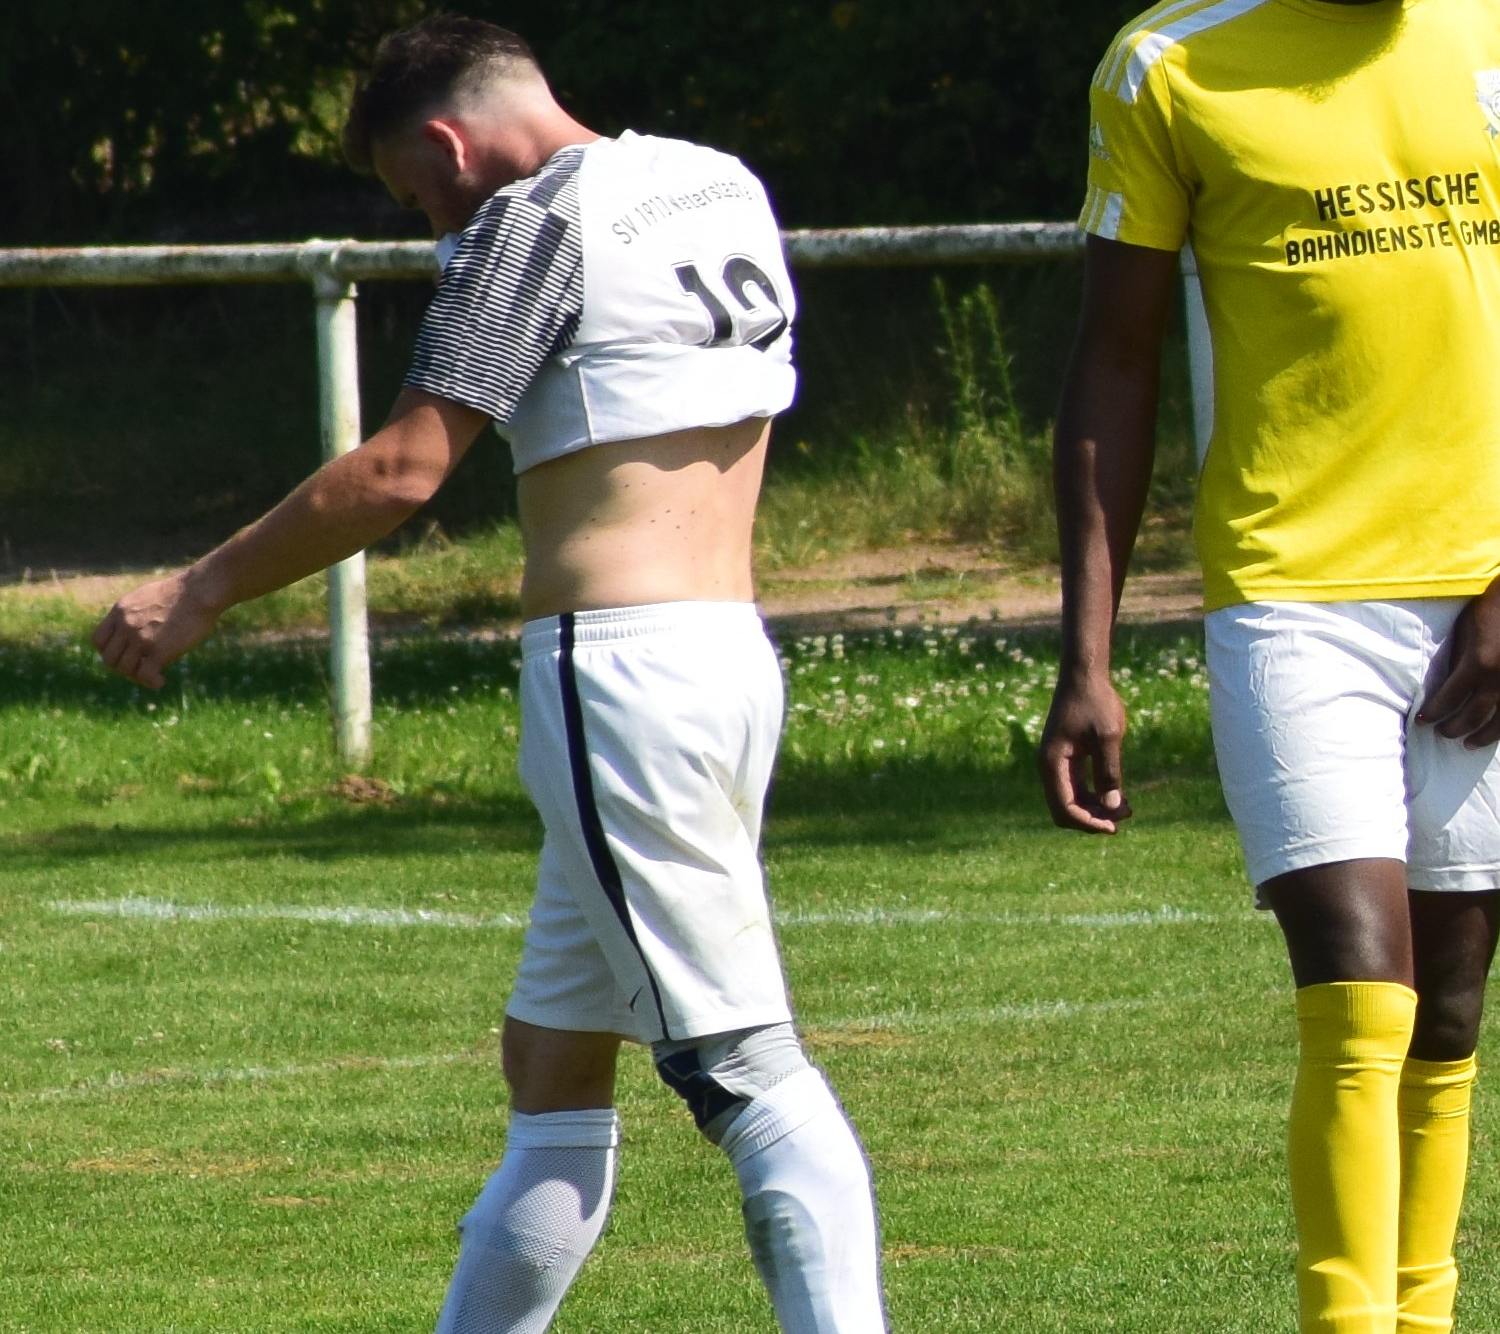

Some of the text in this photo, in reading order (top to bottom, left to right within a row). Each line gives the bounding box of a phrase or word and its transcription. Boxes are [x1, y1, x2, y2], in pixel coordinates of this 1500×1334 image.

[1314, 172, 1480, 221] HESSISCHE
[612, 214, 640, 245] SV
[1285, 219, 1453, 266] BAHNDIENSTE
